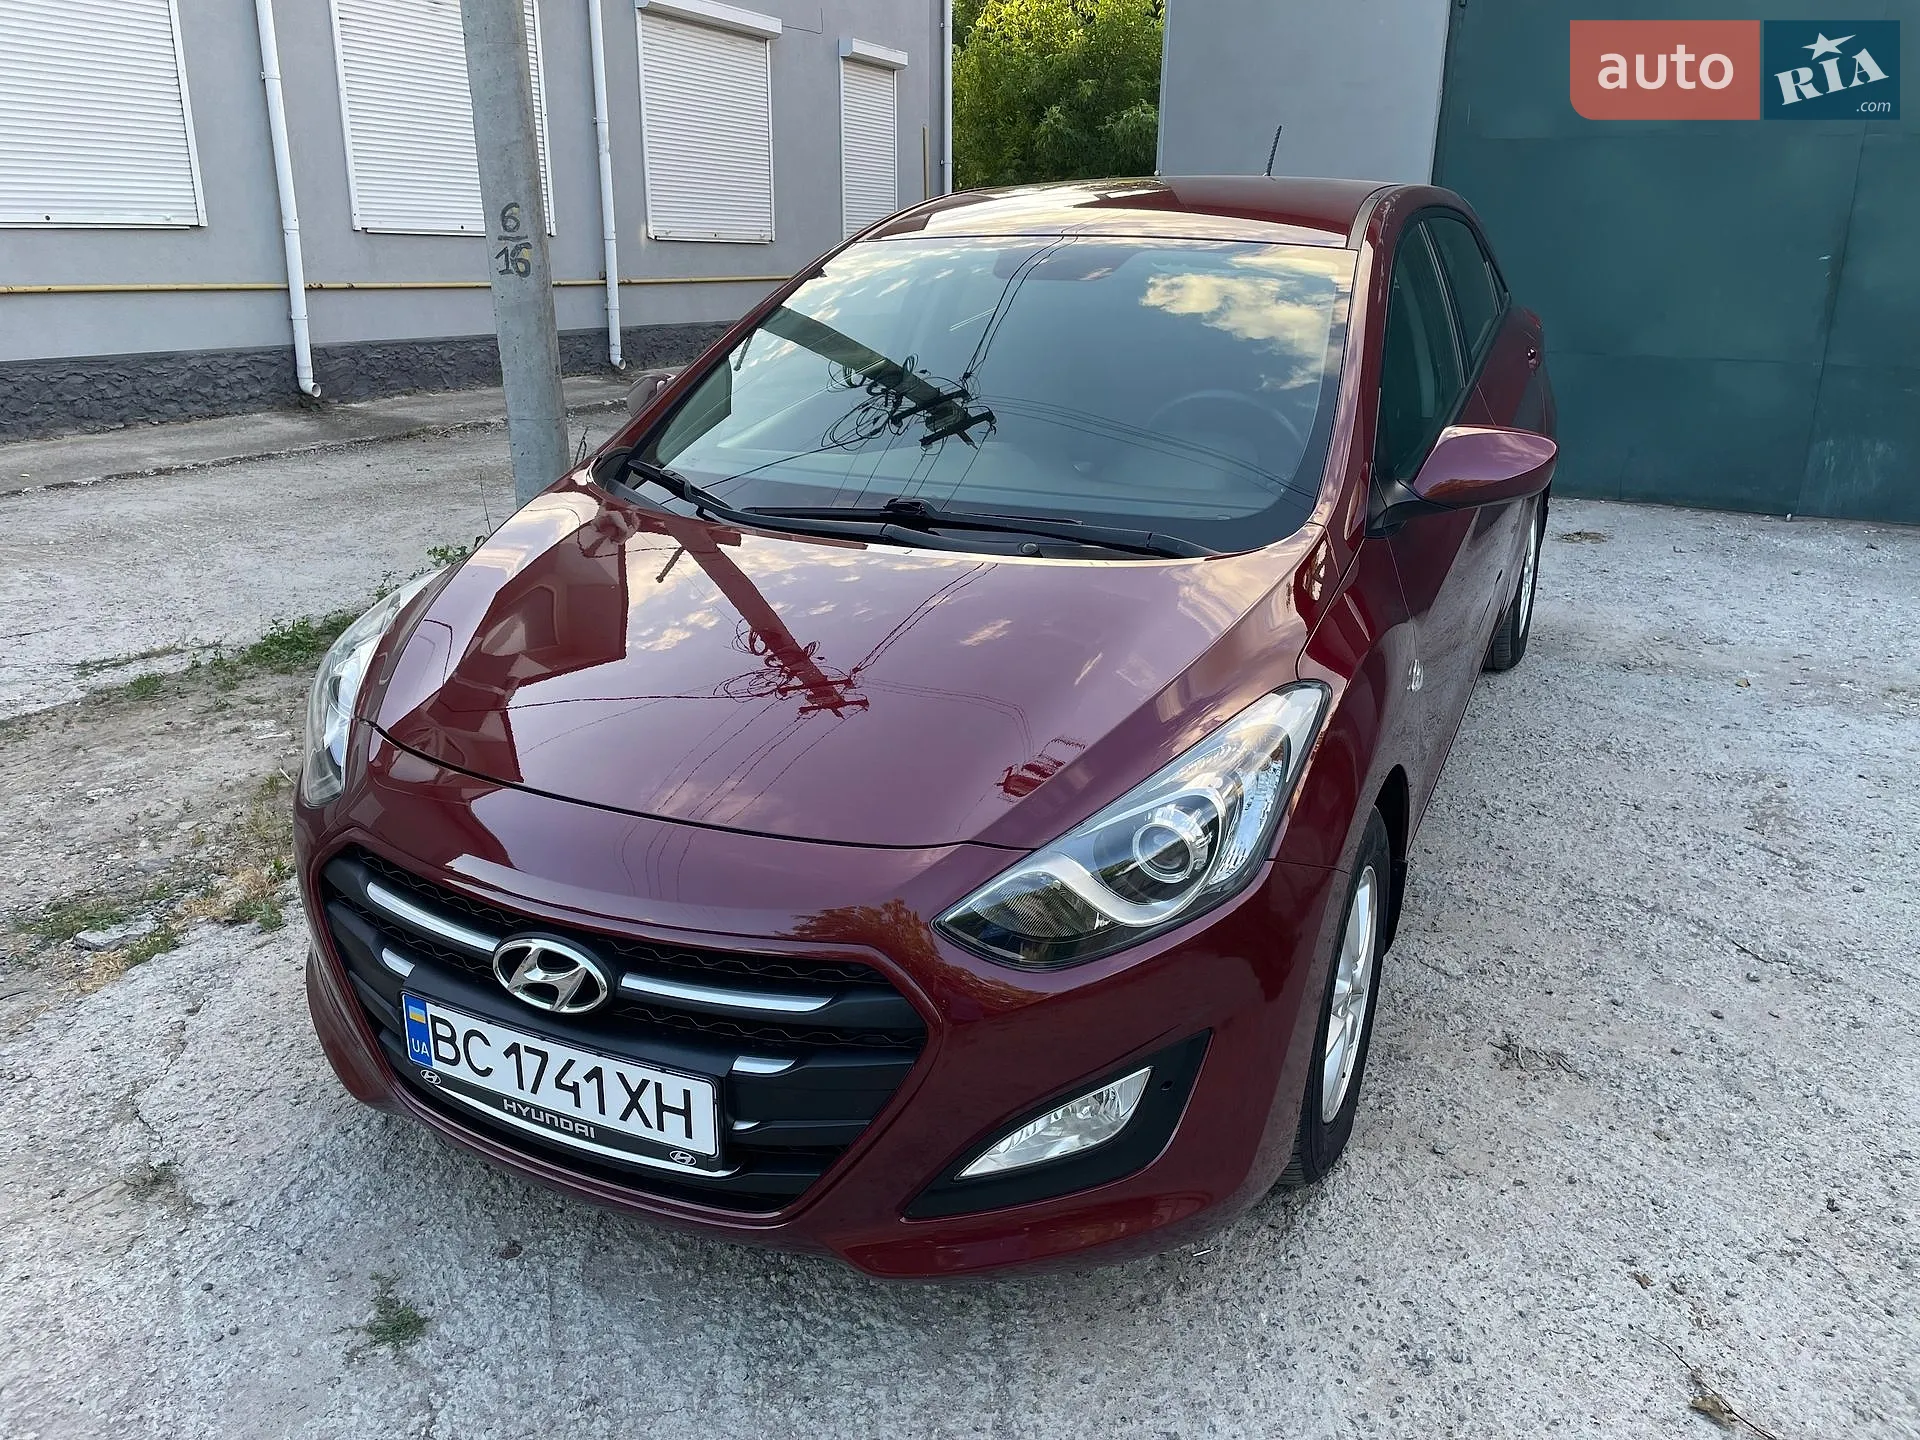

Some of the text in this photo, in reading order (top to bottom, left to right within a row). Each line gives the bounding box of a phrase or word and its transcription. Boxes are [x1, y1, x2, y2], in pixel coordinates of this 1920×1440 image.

[500, 202, 520, 232] 6
[494, 241, 532, 278] 16
[411, 1038, 430, 1057] UA
[503, 1098, 595, 1139] HYUNDAI
